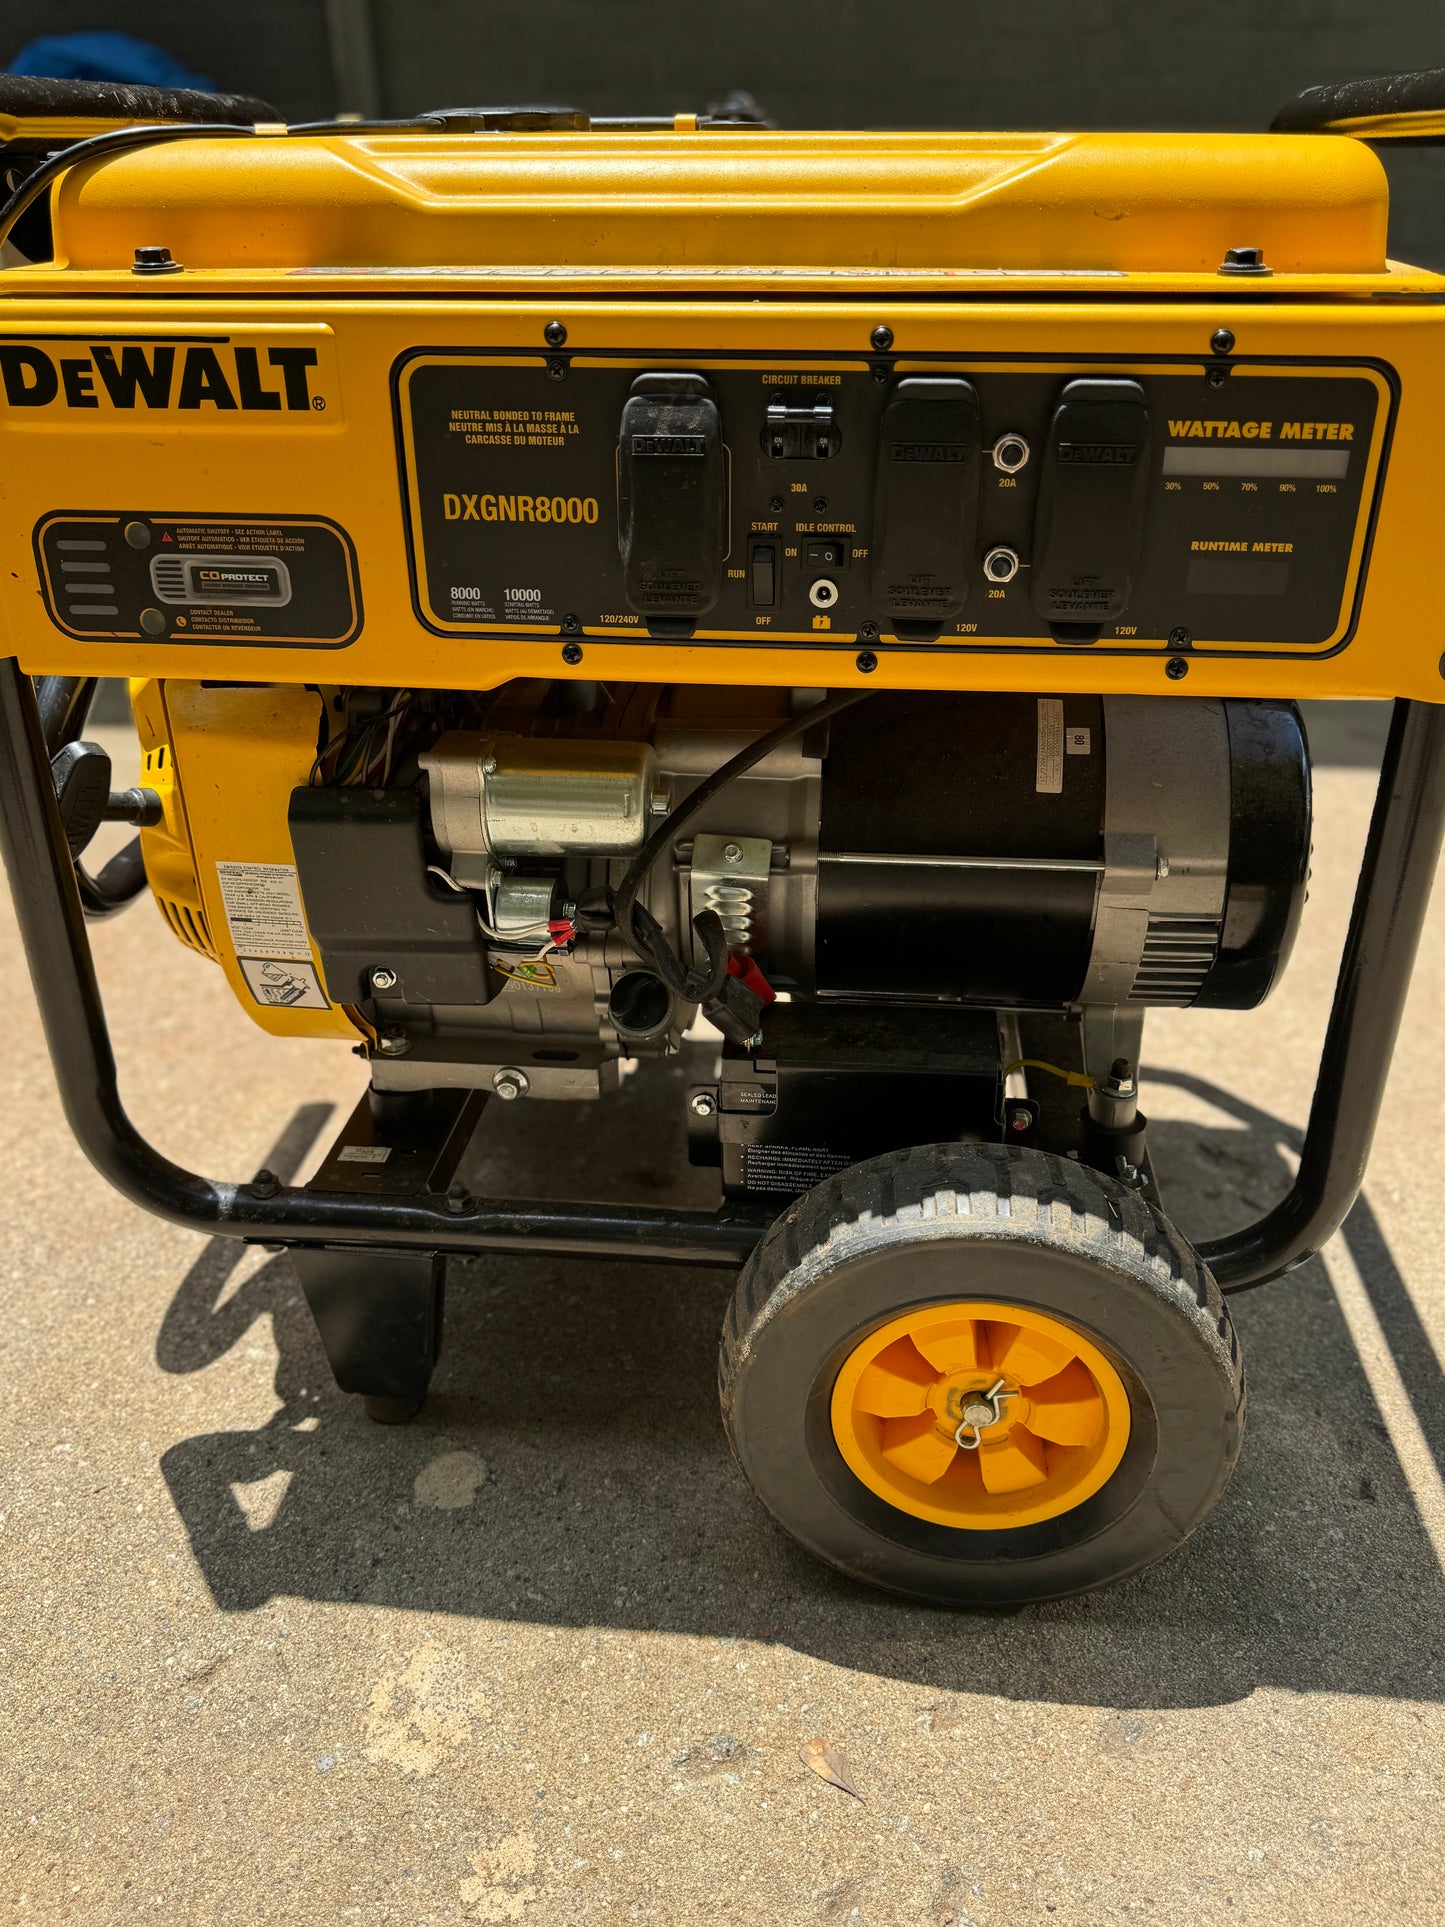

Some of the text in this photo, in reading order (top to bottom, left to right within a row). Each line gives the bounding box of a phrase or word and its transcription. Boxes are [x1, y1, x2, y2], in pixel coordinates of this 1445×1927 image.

[762, 375, 841, 386] CIRCUIT BREAKER
[451, 410, 575, 422] NEUTRAL BONDED TO FRAME
[449, 421, 579, 434] NEUTRE MIS À LA MASSE À LA
[1168, 420, 1355, 441] WATTAGE METER
[465, 433, 564, 446] CARCASSE DU MOTEUR
[791, 483, 808, 493] 30A
[998, 478, 1017, 488] 20A
[1165, 482, 1182, 491] 30%
[1203, 482, 1220, 491] 50%
[1241, 482, 1258, 492] 70%
[1279, 483, 1296, 493] 90%
[1316, 484, 1337, 494] 100%
[443, 493, 599, 524] DXGNR8000
[751, 522, 779, 532] START
[795, 523, 857, 534] IDLE CONTROL
[785, 547, 797, 557] ON
[1190, 541, 1293, 553] RUNTIME METER
[852, 549, 869, 558] OFF
[221, 574, 269, 582] PROTECT
[659, 570, 685, 580] LIFT
[728, 569, 745, 579] RUN
[910, 574, 935, 585] LIFT
[1070, 576, 1098, 587] LIFT
[450, 587, 481, 600] 8000
[504, 588, 541, 602] 10000
[988, 590, 1006, 599] 20A
[599, 614, 639, 625] 120/240V
[755, 616, 772, 625] OFF
[955, 623, 977, 633] 120V
[1114, 626, 1137, 636] 120V
